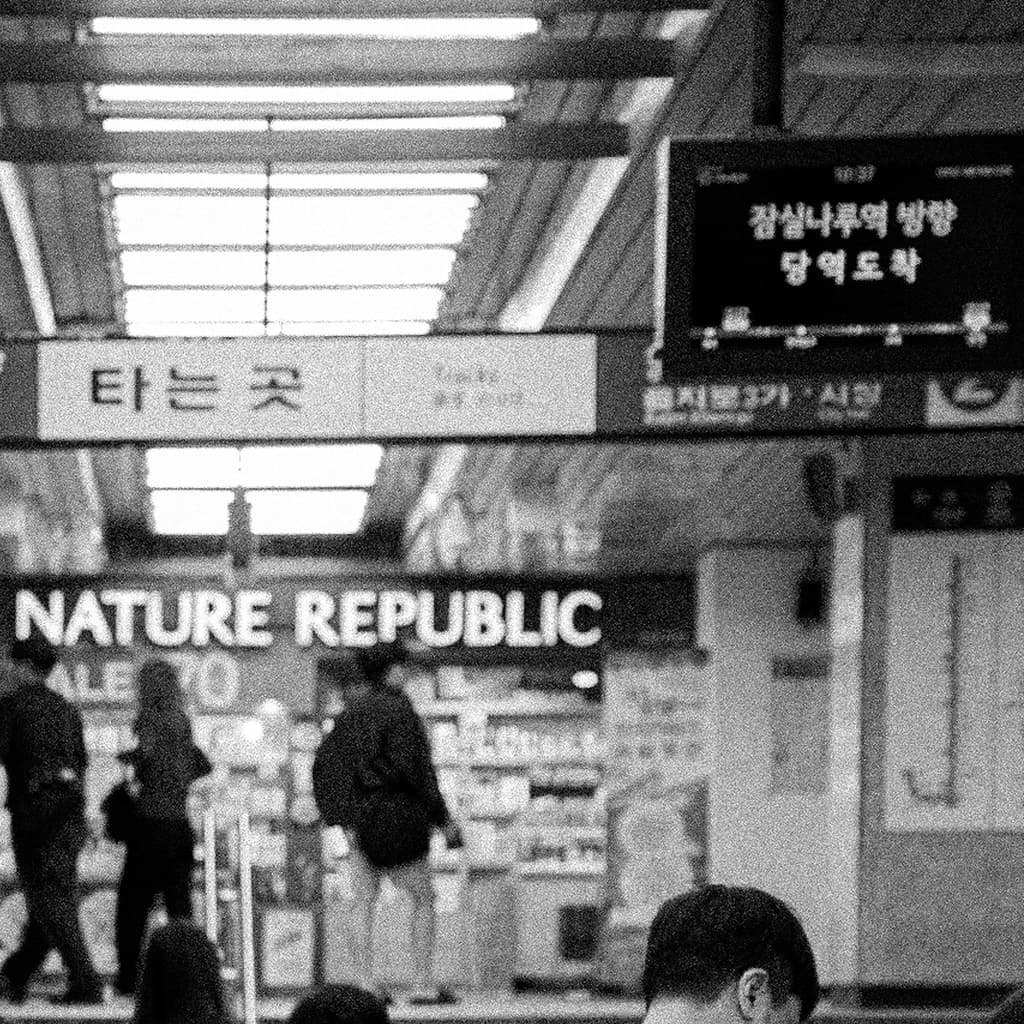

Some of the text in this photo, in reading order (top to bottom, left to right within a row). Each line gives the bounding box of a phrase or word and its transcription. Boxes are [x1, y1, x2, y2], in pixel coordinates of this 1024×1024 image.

[896, 199, 958, 238] 방향
[91, 365, 302, 412] 타는 곳
[15, 589, 603, 648] NATURE REPUBLIC
[45, 661, 135, 703] ALE
